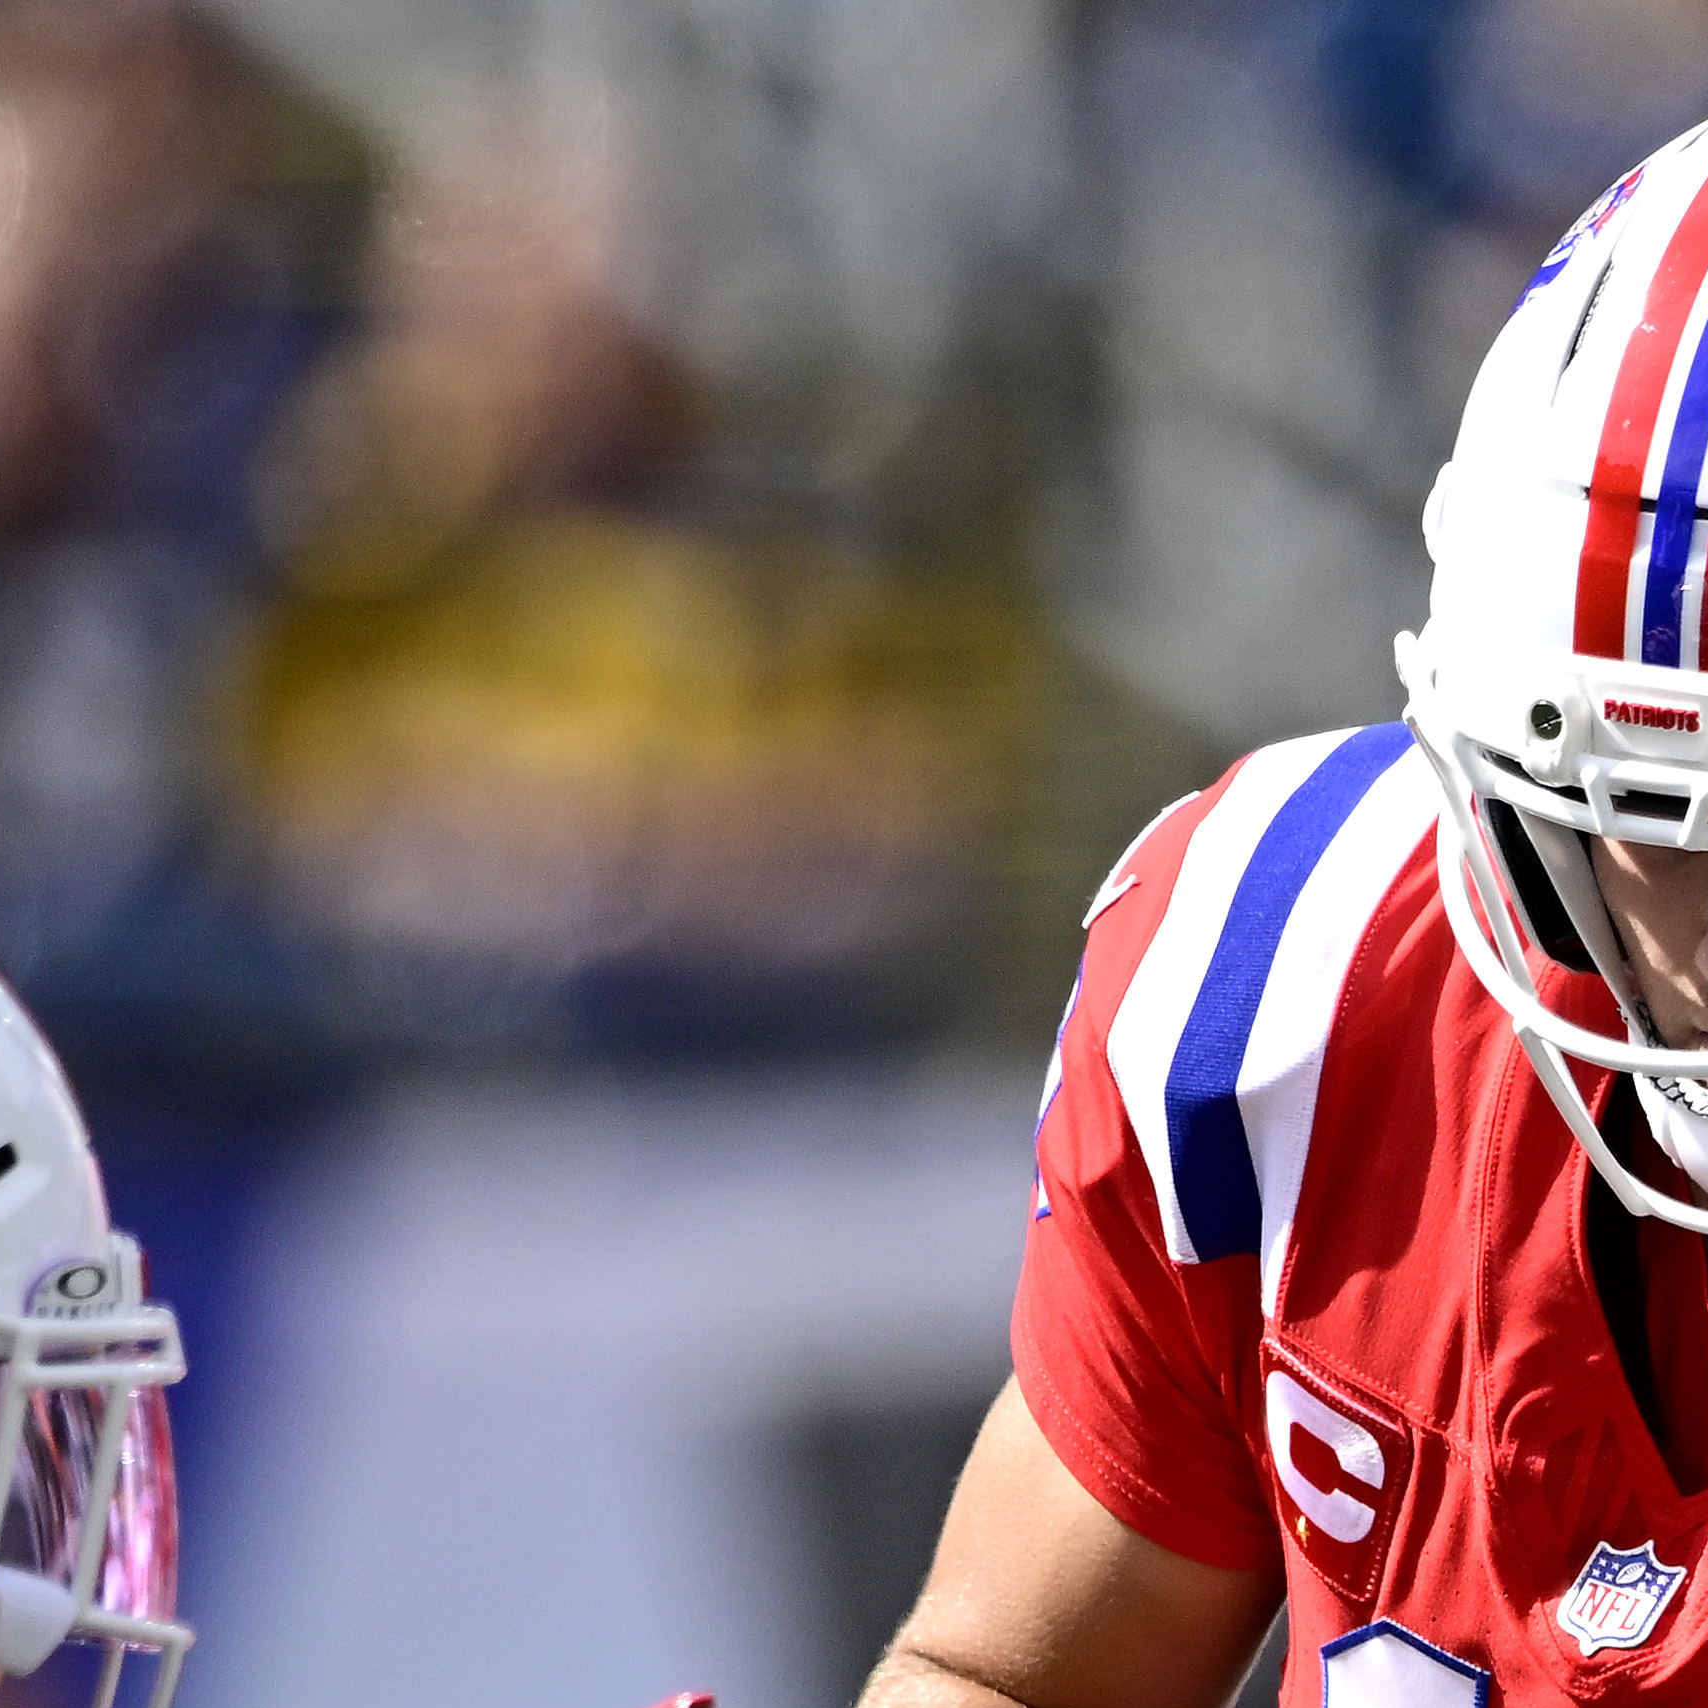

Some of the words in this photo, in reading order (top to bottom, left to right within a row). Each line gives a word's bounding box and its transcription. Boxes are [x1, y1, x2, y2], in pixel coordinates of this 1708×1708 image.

[1604, 698, 1701, 733] PATRIOTS
[1266, 1370, 1385, 1543] C
[1576, 1583, 1641, 1631] NFL
